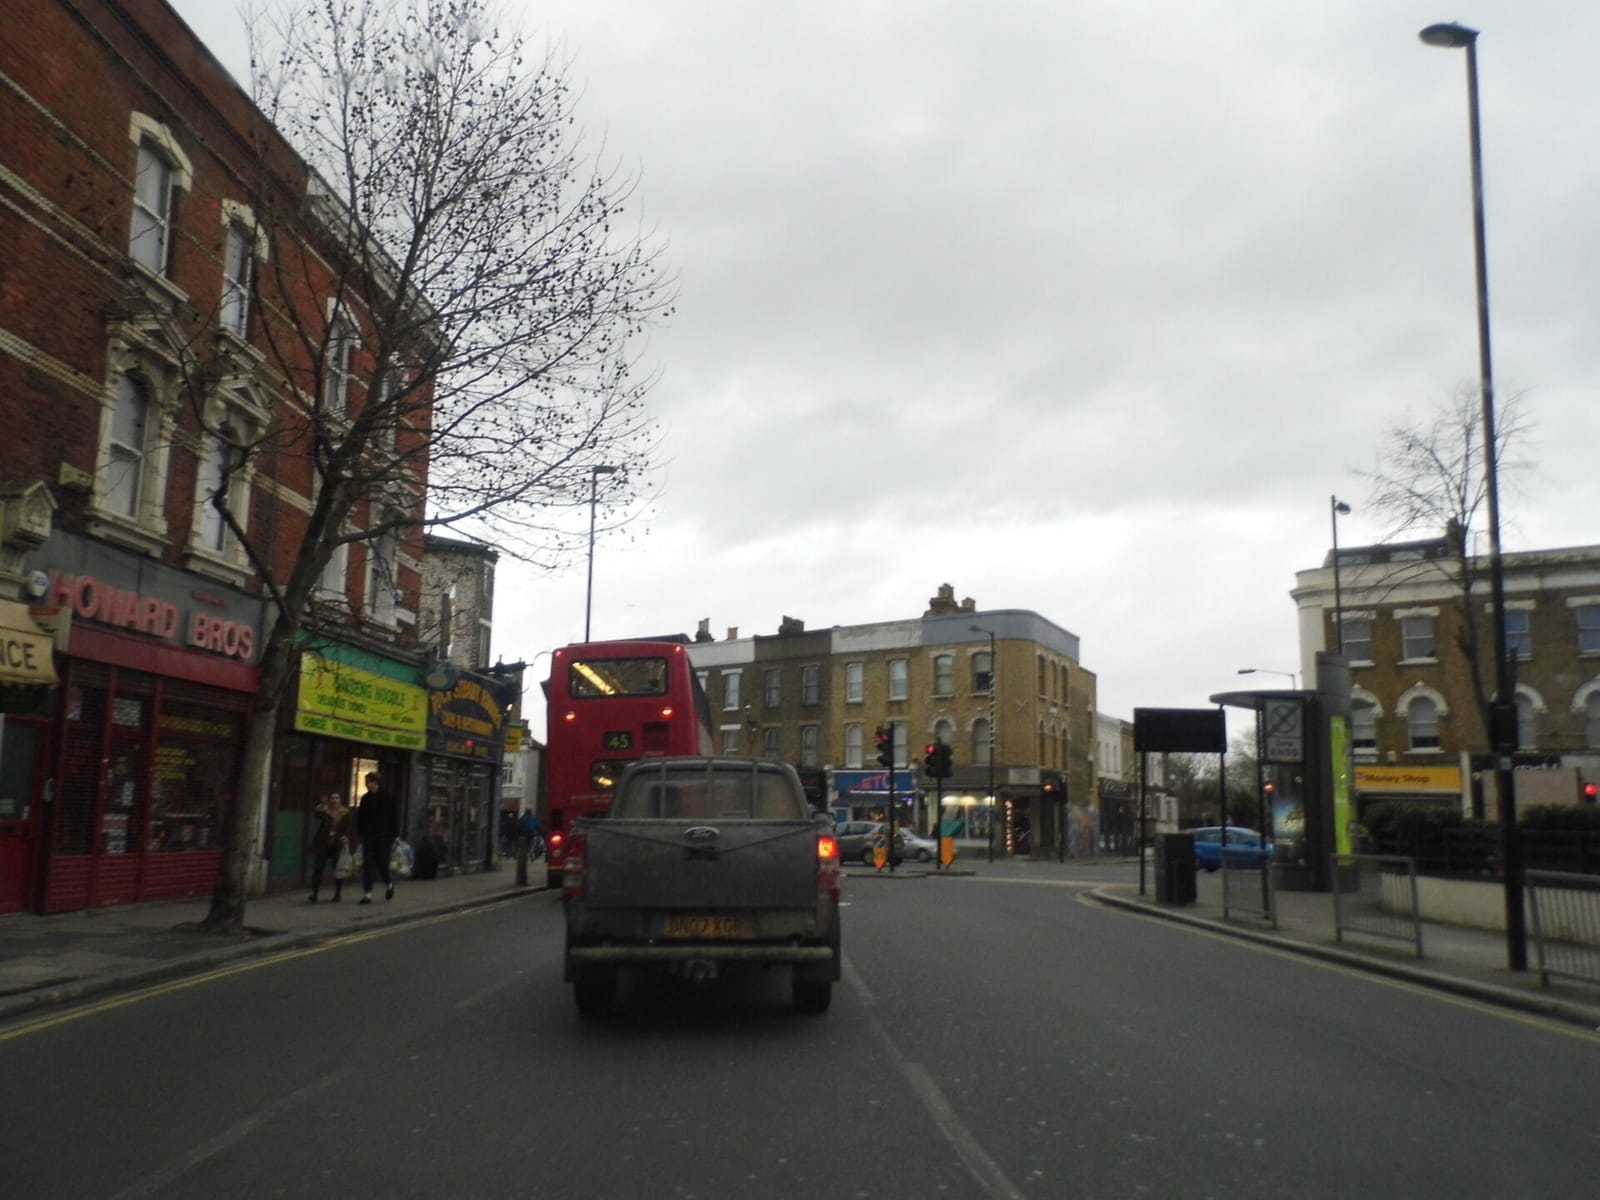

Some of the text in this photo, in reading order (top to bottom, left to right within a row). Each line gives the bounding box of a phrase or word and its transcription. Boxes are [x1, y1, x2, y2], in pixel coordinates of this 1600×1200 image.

[50, 568, 254, 658] HOWARD BROS
[608, 733, 631, 749] 45
[1402, 774, 1430, 784] Shop
